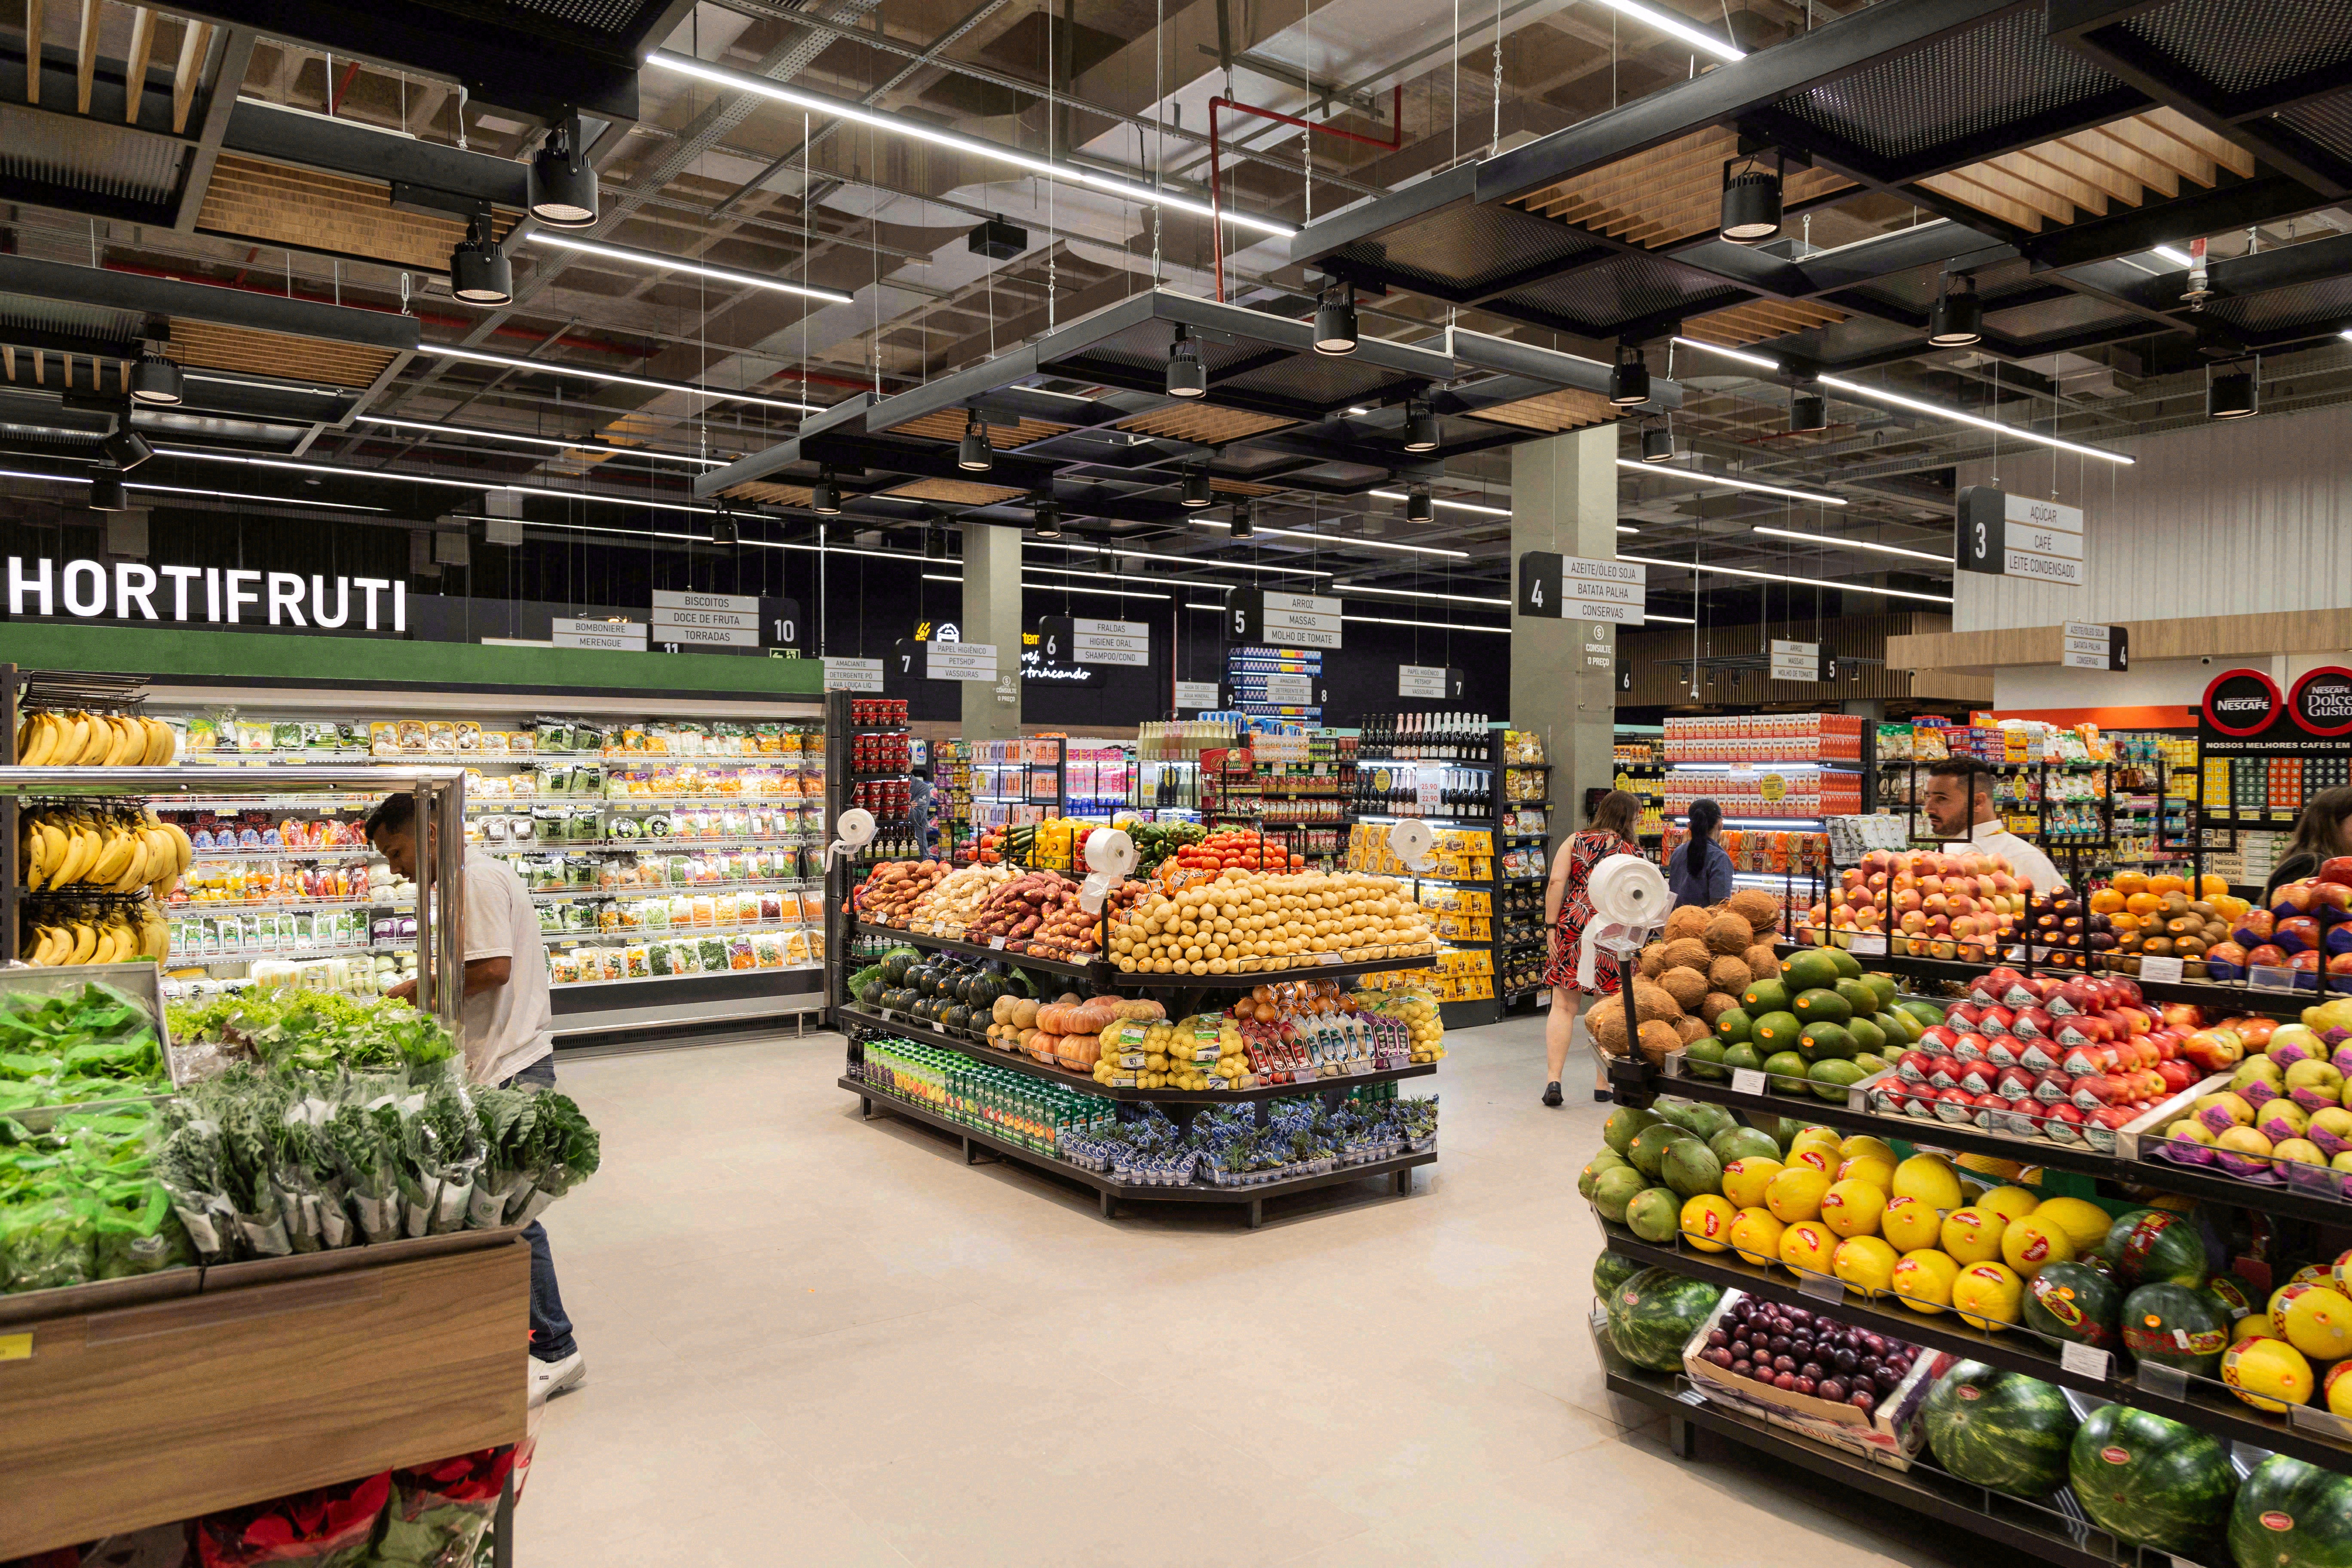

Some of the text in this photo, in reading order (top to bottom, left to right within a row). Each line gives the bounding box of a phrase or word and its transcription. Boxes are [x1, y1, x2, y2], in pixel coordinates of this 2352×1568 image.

[2030, 504, 2057, 523] AÇÚCAR
[1975, 523, 1986, 558] 3
[2035, 534, 2052, 551] CAFÉ
[1571, 561, 1636, 579] AZEITE/ÓLEO SOJA
[2009, 555, 2075, 578] LEITE CONDENSADO
[8, 556, 406, 631] HORTIFRUTI
[1531, 579, 1543, 607] 4
[1578, 584, 1628, 599] BATATA PALHA
[685, 596, 729, 607] BISCOITOS
[1292, 598, 1313, 609] ARROZ
[1582, 605, 1623, 619] CONSERVAS
[674, 613, 740, 625] DOCE DE FRUTA
[1235, 611, 1245, 633] 5
[1289, 615, 1316, 626] MASSAS
[576, 623, 625, 633] BOMBONIERE
[774, 619, 794, 641] 10
[1097, 624, 1125, 633] FRALDAS
[2095, 629, 2104, 637] SOJA
[685, 631, 730, 641] TORRADAS
[1272, 631, 1332, 643] MOLHO DE TOMATE
[579, 638, 622, 647] MERENGUE
[1047, 635, 1056, 655] 6
[1090, 638, 1132, 647] HIGIENE ORAL
[2074, 640, 2100, 651] BATATA PALHA
[937, 643, 986, 654] PAPEL HIGIÊNICO
[1586, 644, 1611, 654] CONSULTE
[1085, 651, 1137, 662] SHAMPOO/COND.
[1788, 657, 1804, 665] MASSAS
[2076, 656, 2098, 665] CONSERVAS
[2120, 646, 2126, 666] 4
[902, 655, 910, 673] 7
[1592, 657, 1609, 668] PREÇO
[1421, 668, 1439, 677] HIGIÊNICO
[1778, 669, 1791, 677] MOLHO
[1798, 669, 1813, 678] TOMATE
[1829, 661, 1835, 678] 5
[866, 671, 873, 680] PÓ
[1624, 674, 1629, 688] 6
[1456, 681, 1461, 695] 7
[2312, 683, 2350, 694] NESCAFÉ
[1228, 695, 1232, 706] 9
[1321, 690, 1326, 701] 8
[2307, 694, 2352, 706] Dolce
[2217, 696, 2269, 710] NESCAFÉ
[2308, 704, 2352, 716] Gusto
[2300, 740, 2332, 748] CAFÉS
[1965, 1046, 1980, 1055] DRT
